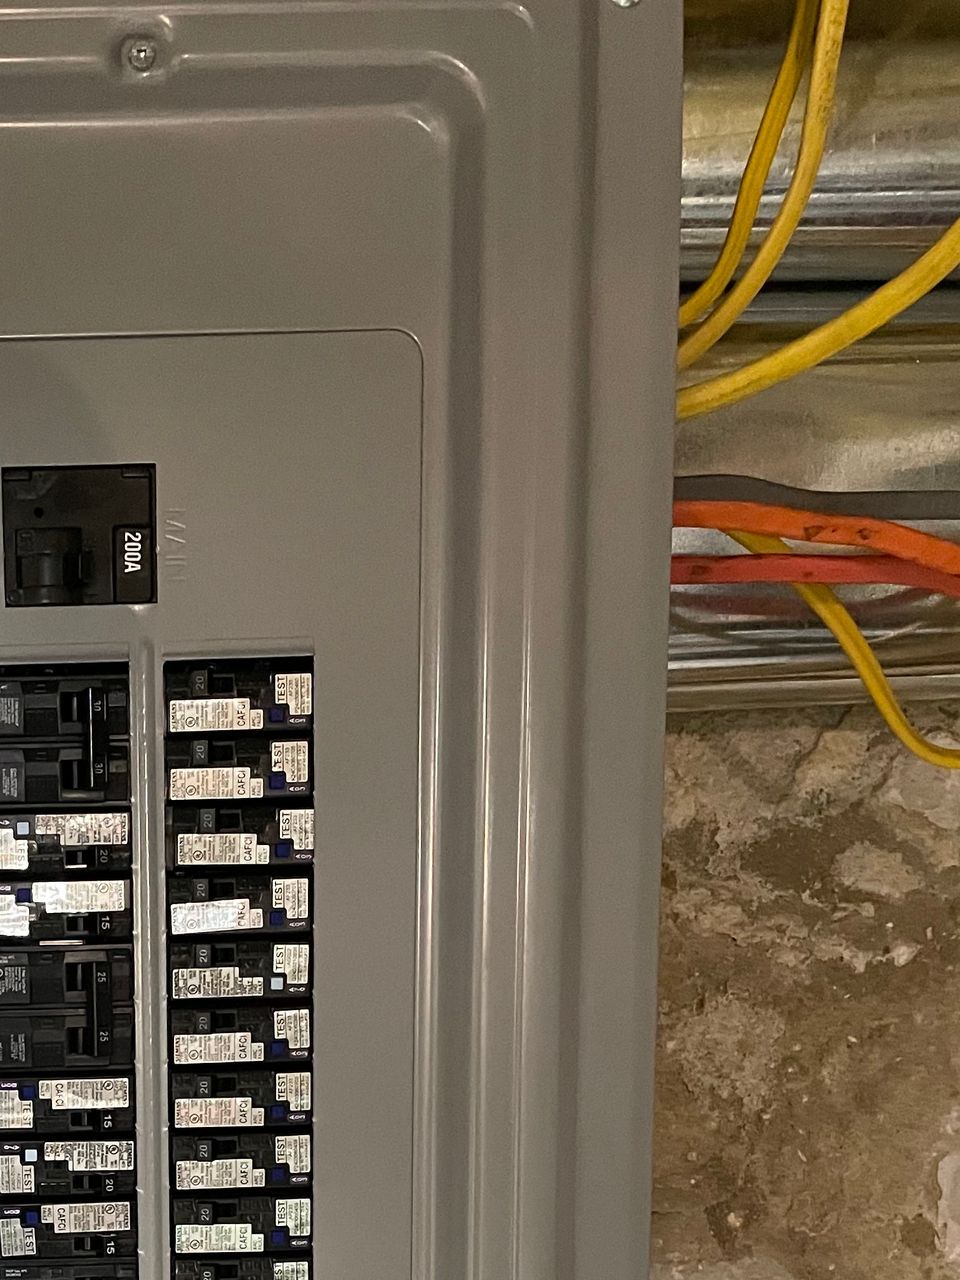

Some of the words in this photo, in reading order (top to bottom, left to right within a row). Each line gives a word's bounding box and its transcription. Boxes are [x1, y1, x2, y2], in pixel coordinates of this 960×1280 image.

[125, 532, 142, 573] 200A
[196, 676, 204, 690] 20
[277, 677, 286, 702] TEST
[237, 701, 246, 726] CAFCI
[196, 745, 204, 759] 20
[238, 771, 246, 795] CAFCI
[204, 814, 212, 828] 20
[282, 812, 290, 838] TEST
[100, 849, 108, 863] 20
[244, 837, 253, 861] CAFCI
[197, 884, 206, 897] 20
[275, 882, 283, 907] TEST
[102, 916, 110, 930] 15
[200, 950, 208, 963] 20
[276, 947, 284, 970] TEST
[98, 972, 106, 983] 25
[199, 1017, 207, 1030] 20
[277, 1013, 285, 1037] TEST
[100, 1032, 108, 1042] 25
[239, 1035, 247, 1059] CAFCI
[55, 1083, 63, 1107] CAFCI
[200, 1082, 208, 1094] 20
[278, 1075, 286, 1099] TEST
[23, 1102, 32, 1126] TEST
[104, 1115, 112, 1128] 15
[240, 1101, 248, 1124] CAFCI
[200, 1145, 208, 1158] 20
[277, 1138, 285, 1162] TEST
[24, 1167, 32, 1191] TEST
[241, 1162, 249, 1185] CAFCI
[106, 1179, 113, 1192] 20
[58, 1208, 66, 1231] CAFCI
[201, 1209, 209, 1221] 20
[278, 1201, 286, 1225] TEST
[25, 1229, 35, 1254] TEST
[107, 1241, 115, 1254] 15
